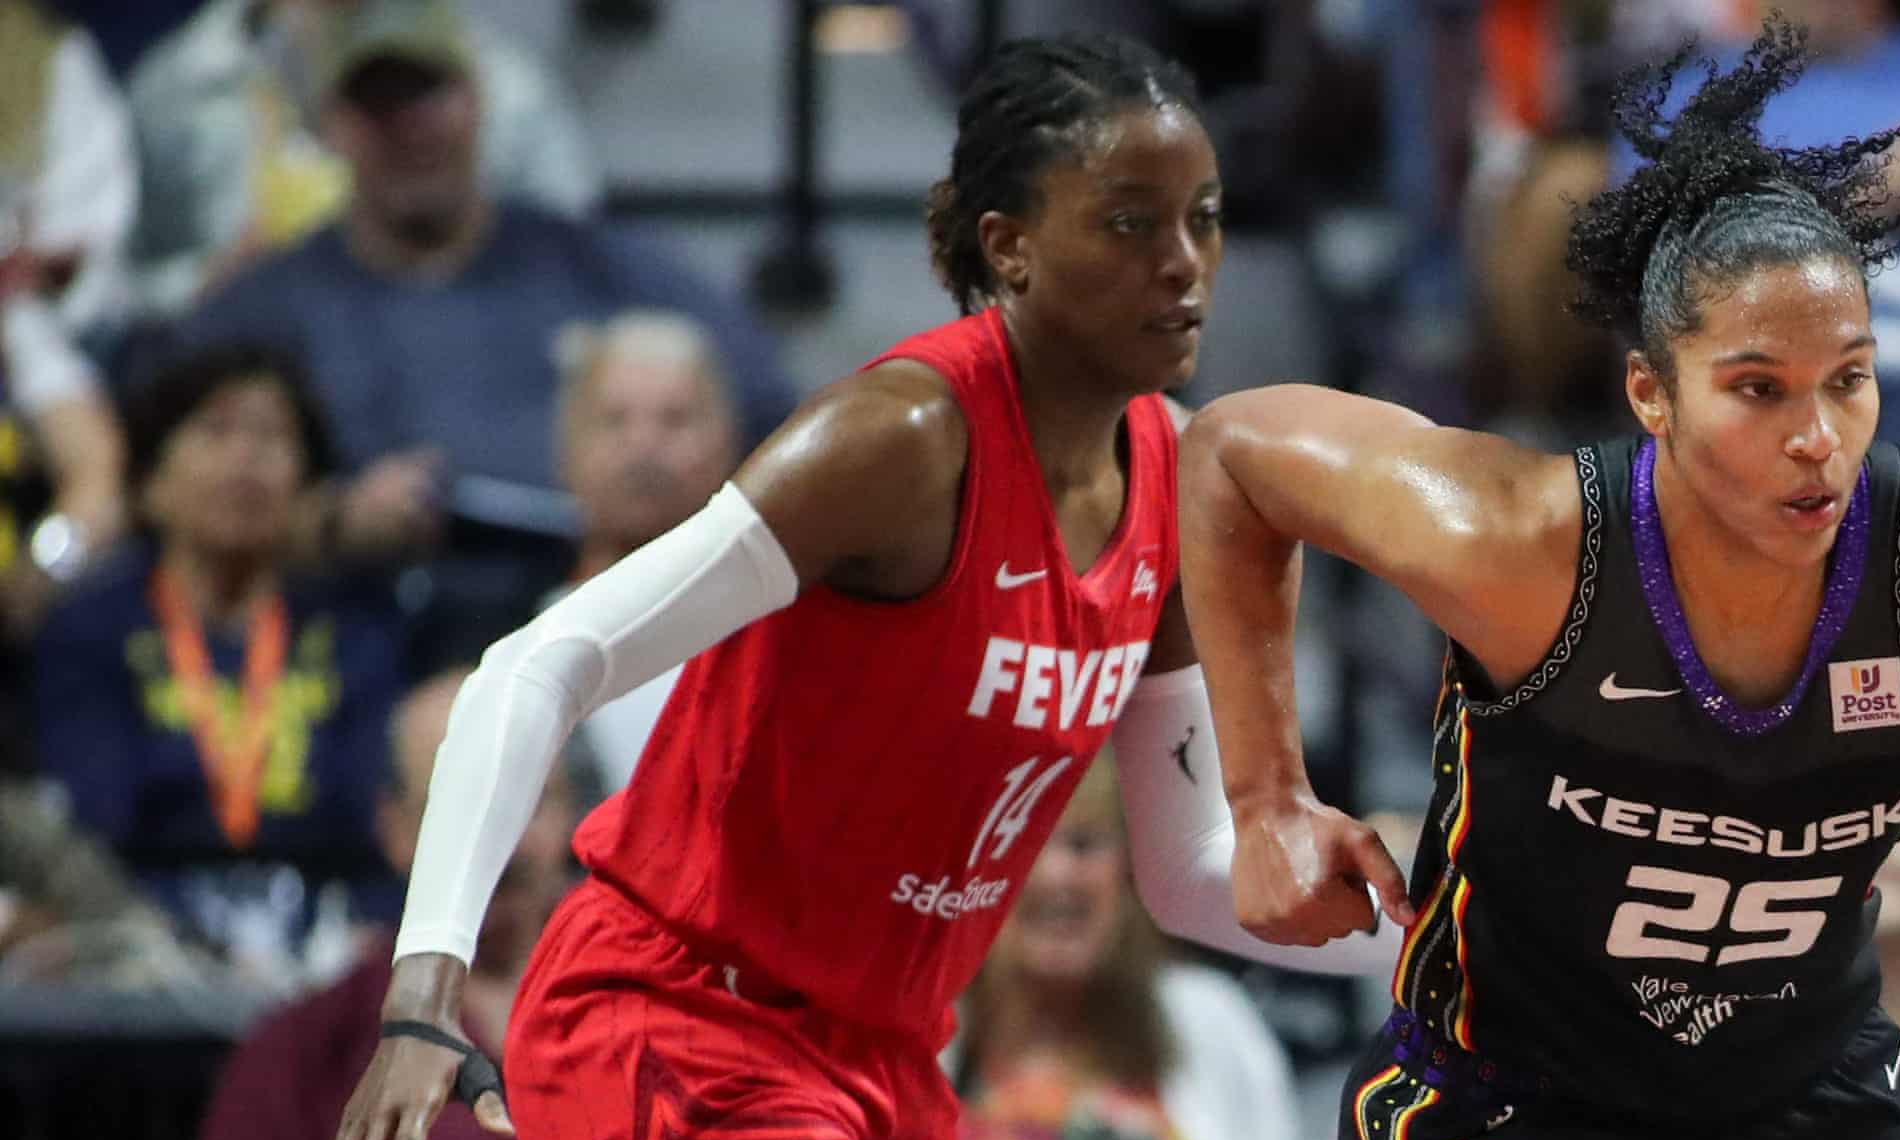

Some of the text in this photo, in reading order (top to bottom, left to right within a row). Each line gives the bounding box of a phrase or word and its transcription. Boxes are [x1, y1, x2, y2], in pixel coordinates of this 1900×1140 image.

[1841, 693, 1897, 714] Post
[967, 756, 1073, 870] 14
[1605, 864, 1844, 967] 25
[1631, 974, 1689, 1006] Yale
